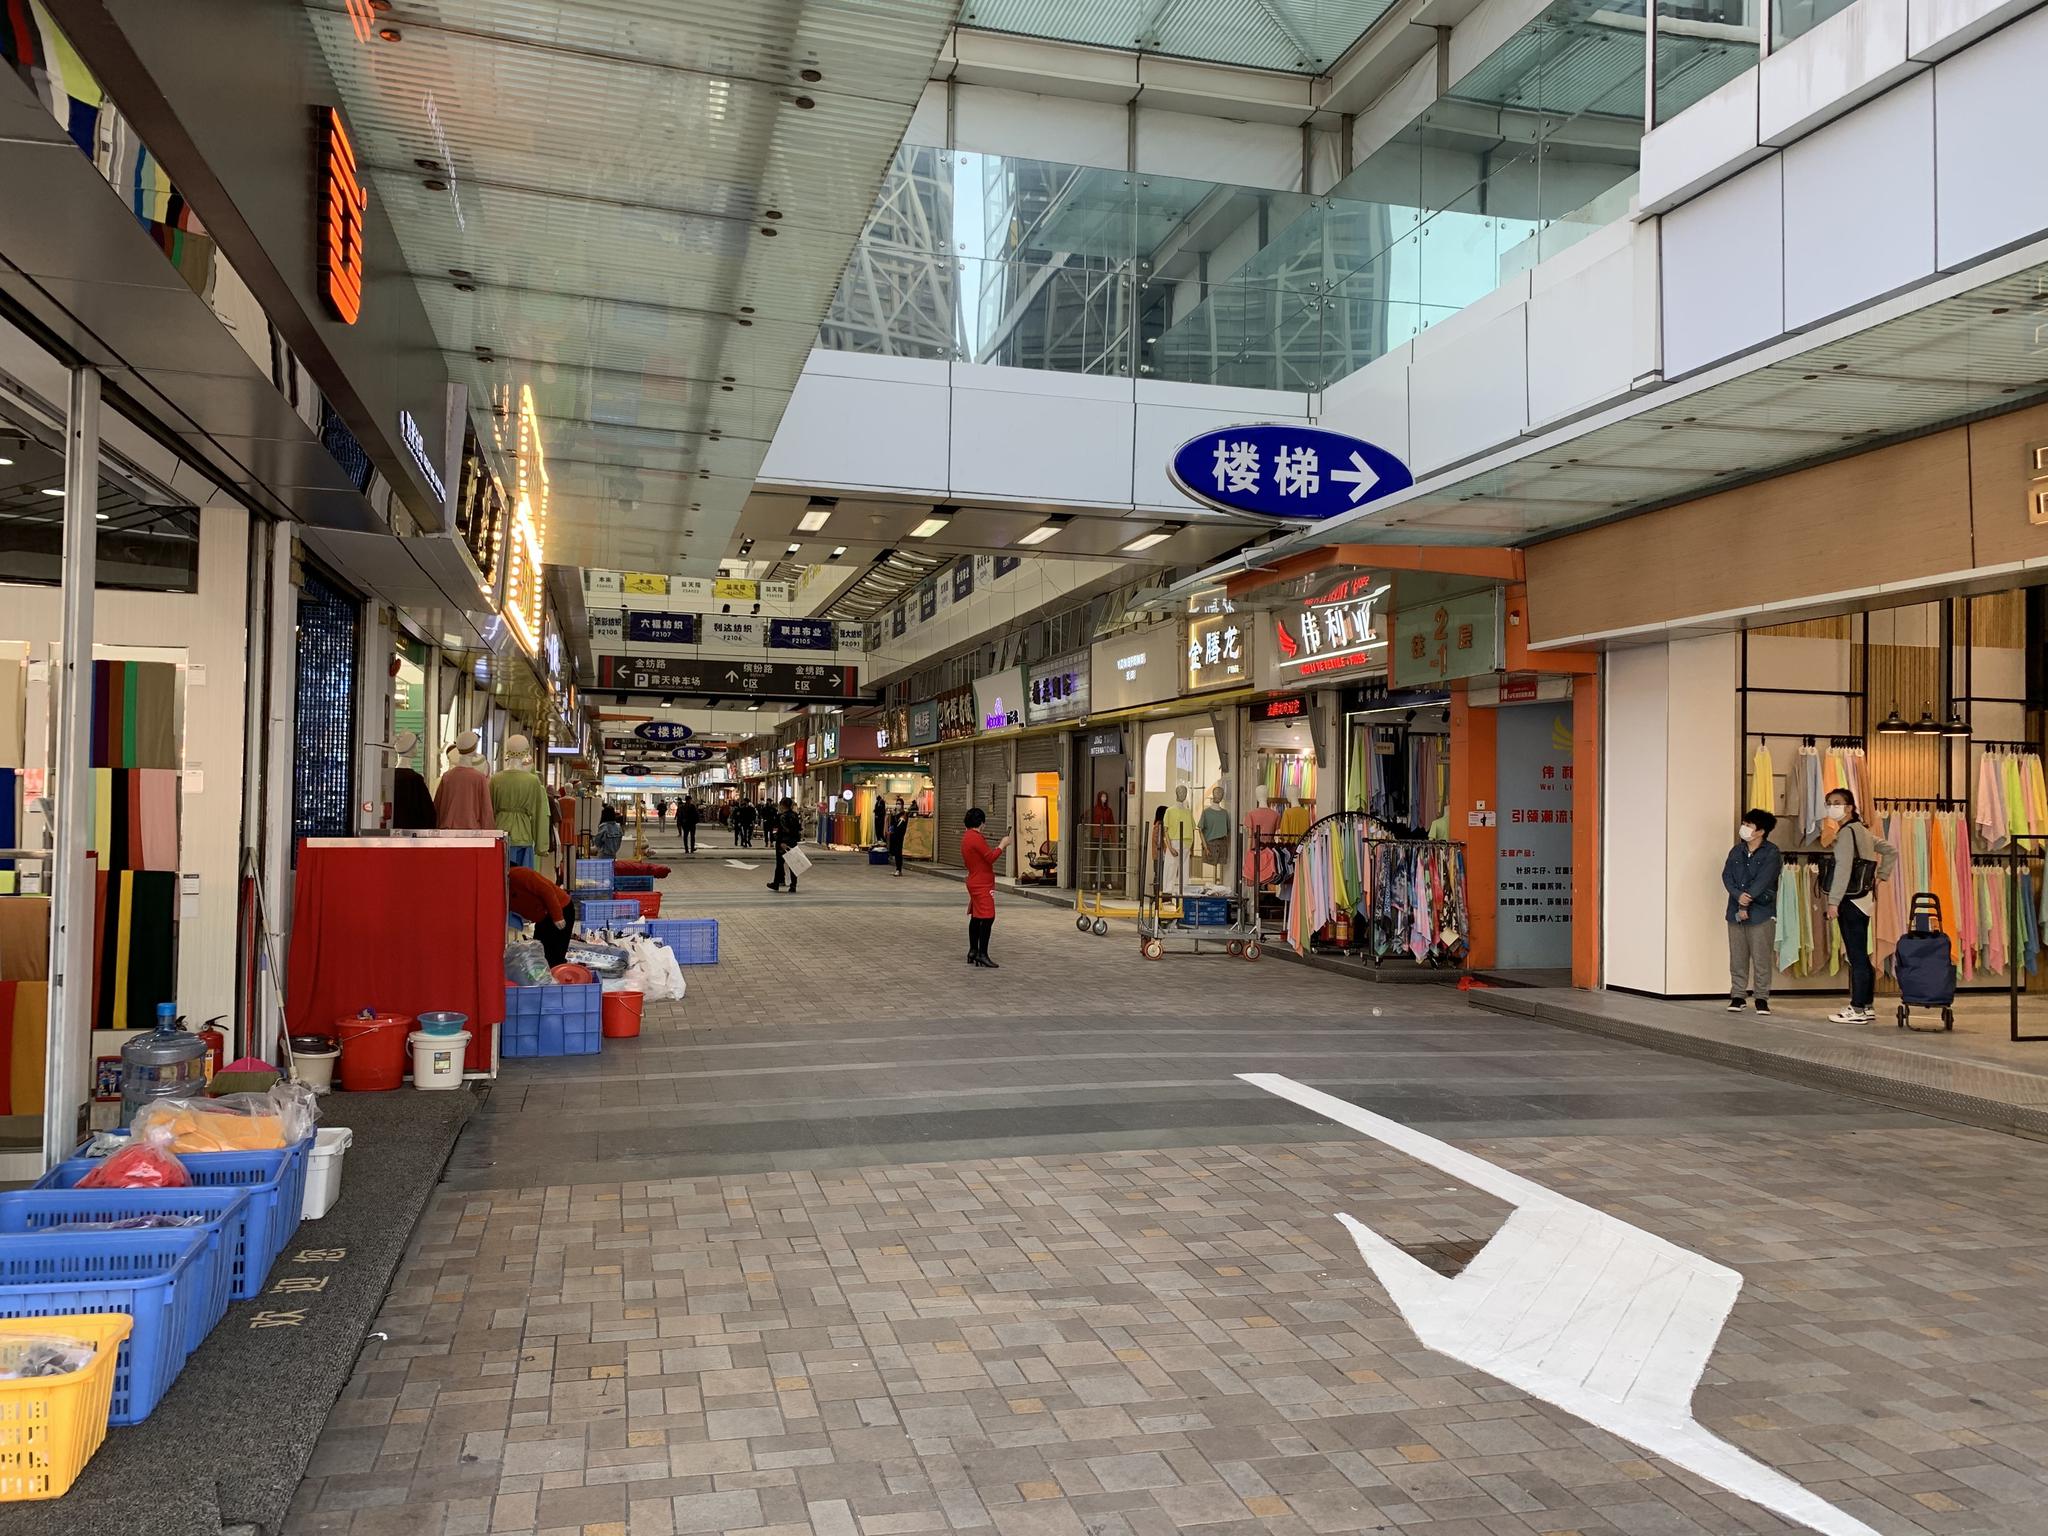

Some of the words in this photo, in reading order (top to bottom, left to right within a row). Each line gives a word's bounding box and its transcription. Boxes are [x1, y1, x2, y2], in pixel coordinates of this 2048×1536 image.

[1212, 439, 1320, 499] 楼梯
[641, 619, 683, 630] 六福纺织
[714, 622, 752, 633] 利达纺织
[1434, 606, 1448, 641] 2
[1458, 623, 1472, 650] 层
[780, 625, 822, 637] 联进布业
[635, 658, 666, 669] 金纺路
[743, 663, 773, 674] 缤纷路
[795, 665, 825, 676] 金绣路
[651, 675, 701, 686] 露天停车场
[742, 678, 758, 689] C区
[794, 680, 810, 691] E区
[657, 725, 684, 737] 楼梯
[677, 749, 696, 758] 电梯
[1512, 809, 1573, 823] 引领潮流
